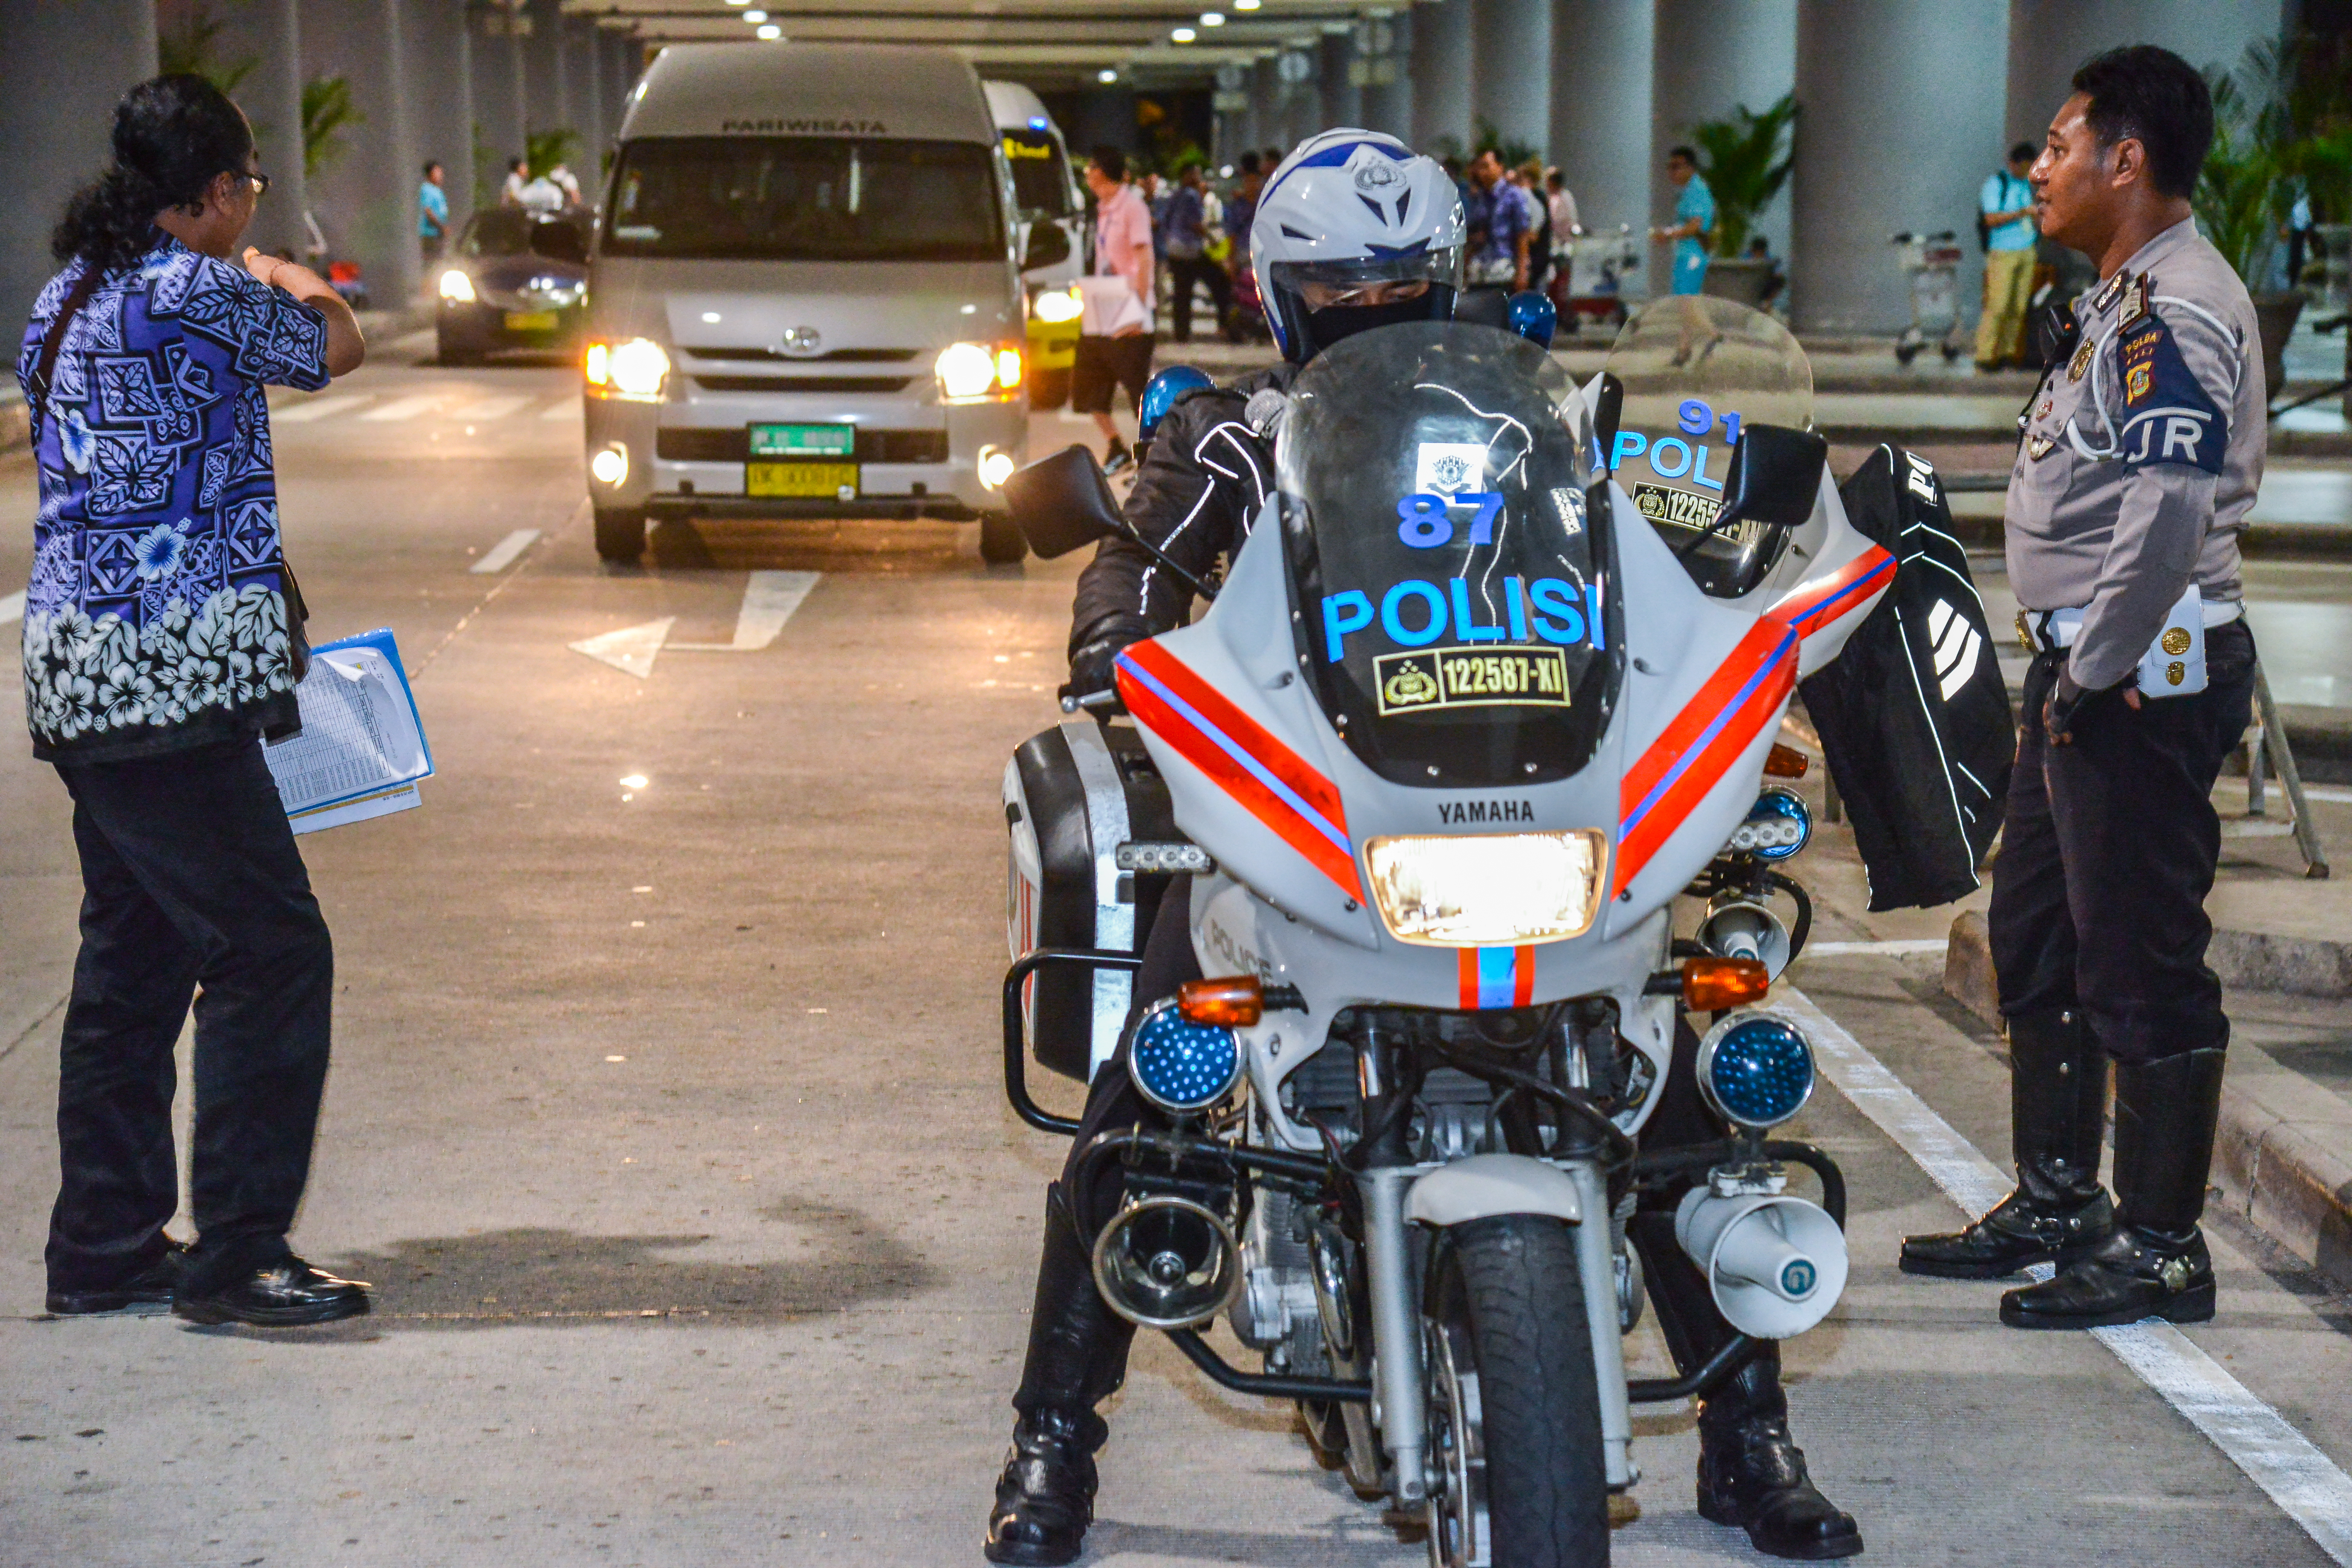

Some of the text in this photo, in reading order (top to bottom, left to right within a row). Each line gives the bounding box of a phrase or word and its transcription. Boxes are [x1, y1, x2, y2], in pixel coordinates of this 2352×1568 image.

[723, 119, 885, 133] PARIWISATA
[1678, 399, 1741, 445] 91
[1397, 492, 1505, 549] 87
[1322, 576, 1605, 663] POLISI
[1443, 657, 1562, 694] 122587-XI
[1438, 801, 1535, 824] YAMAHA
